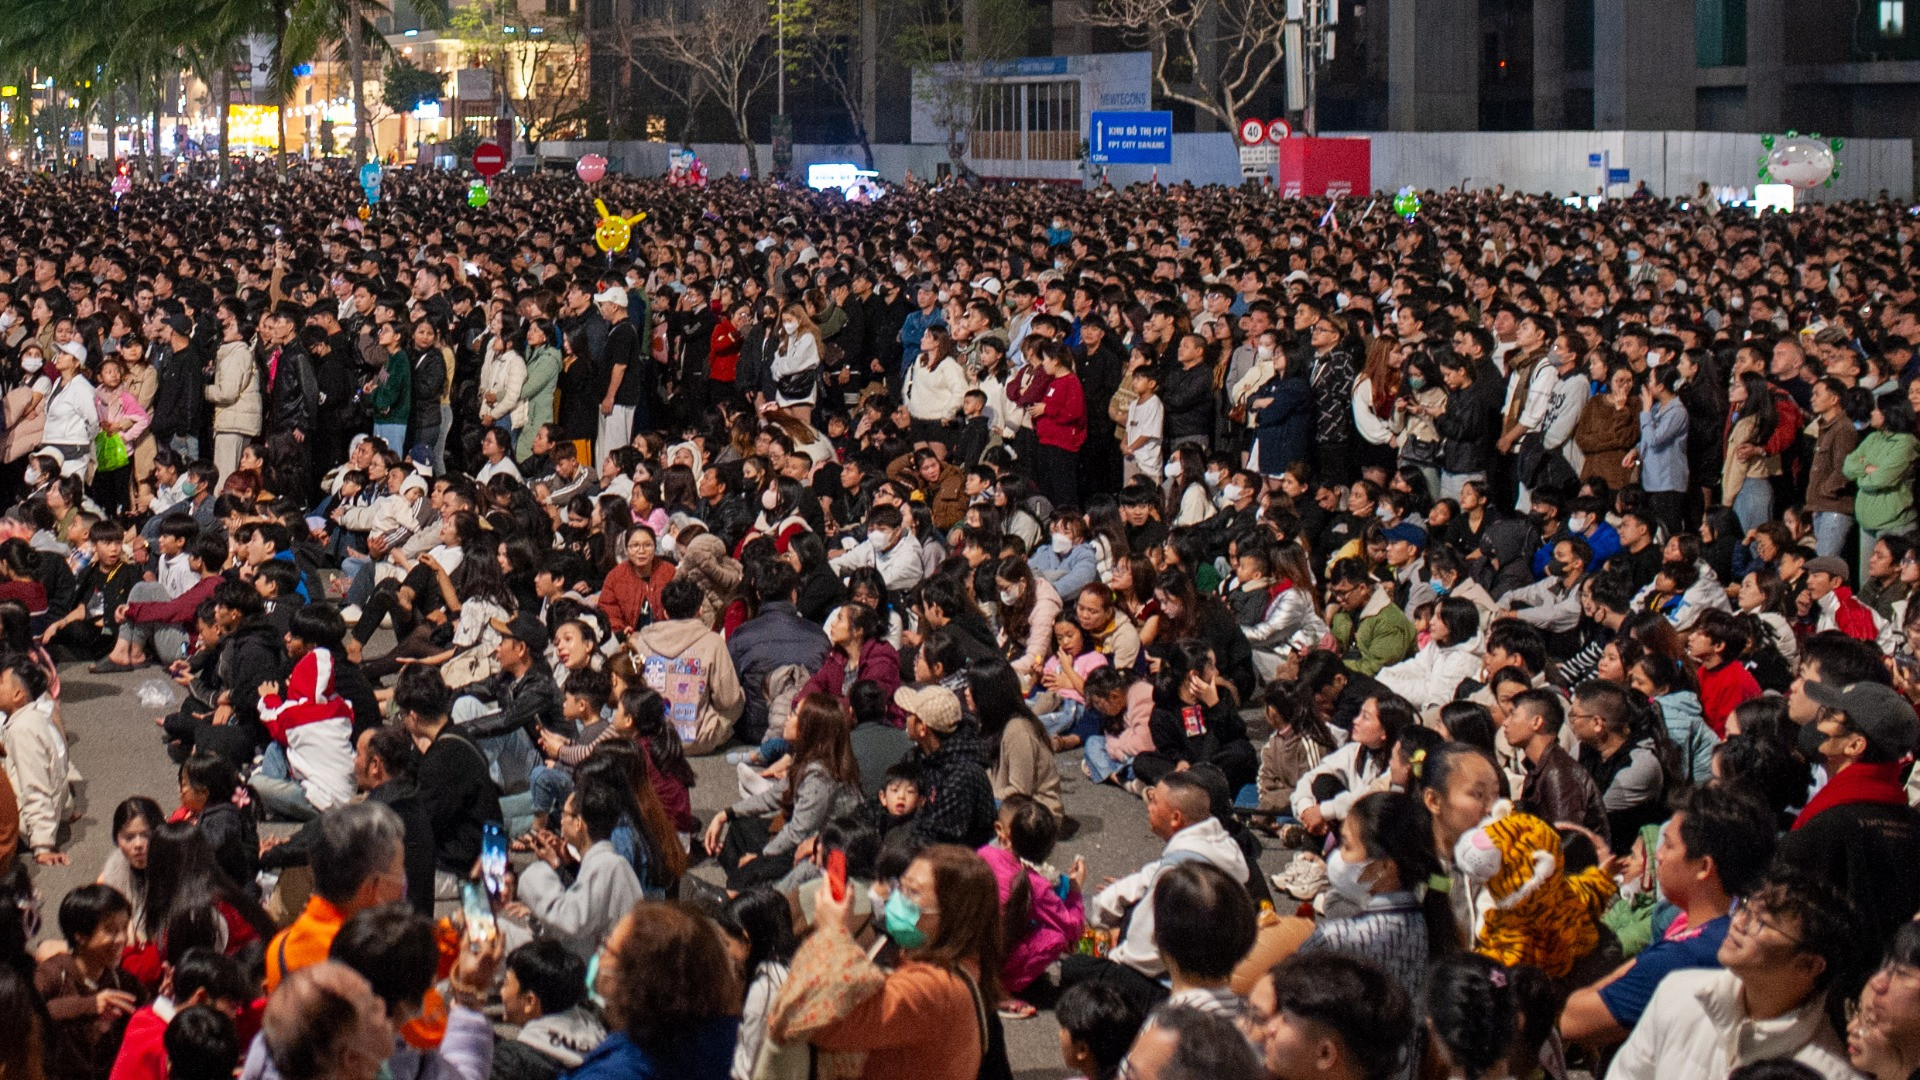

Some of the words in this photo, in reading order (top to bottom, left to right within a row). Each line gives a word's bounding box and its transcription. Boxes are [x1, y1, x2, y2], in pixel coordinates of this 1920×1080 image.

[1100, 92, 1147, 106] NEWTECONS
[1108, 126, 1124, 135] KHU
[1153, 126, 1167, 135] FPT
[1247, 125, 1259, 138] 40
[1108, 141, 1120, 149] FPT
[1121, 141, 1136, 149] CITY
[1137, 141, 1165, 149] DANANG
